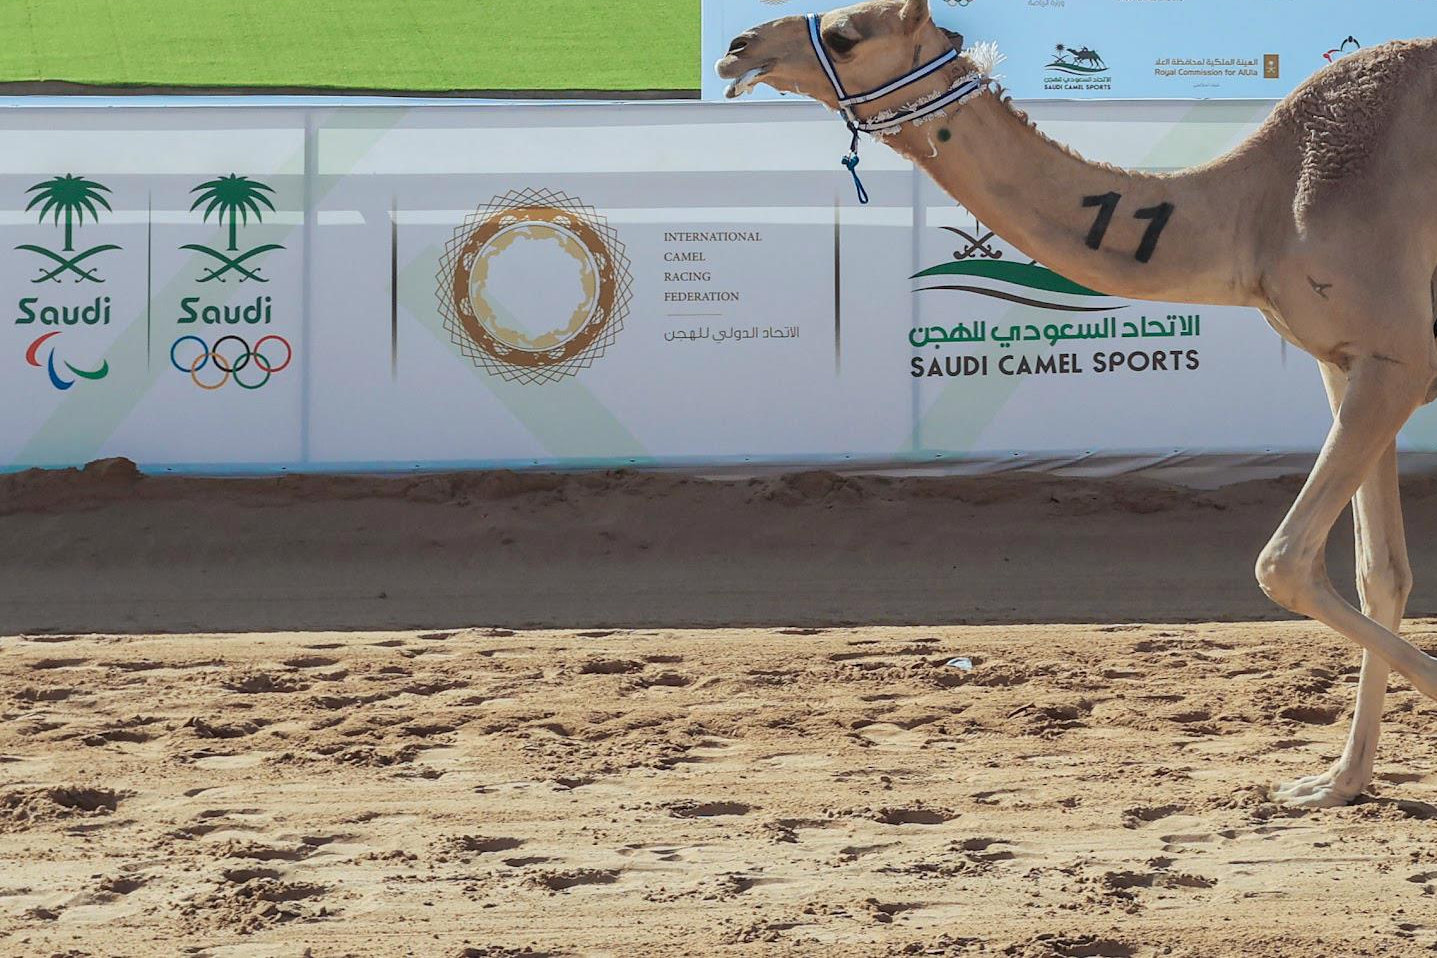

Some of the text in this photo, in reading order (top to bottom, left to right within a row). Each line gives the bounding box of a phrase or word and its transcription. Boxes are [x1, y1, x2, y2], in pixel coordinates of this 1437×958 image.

[1154, 69, 1177, 77] Royal
[1082, 191, 1175, 263] 11
[664, 232, 762, 242] INTERNATIONAL
[664, 252, 706, 262] CAMEL
[664, 272, 711, 282] RACING
[664, 291, 739, 302] FEDERATION
[15, 296, 111, 325] Saudi
[177, 295, 272, 325] Saudi
[664, 326, 800, 343] الاتحاد الدولي للهجن
[909, 314, 1201, 349] الاتحاد السعودي للهجن
[910, 349, 1199, 378] SAUDI CAMEL SPORTS
